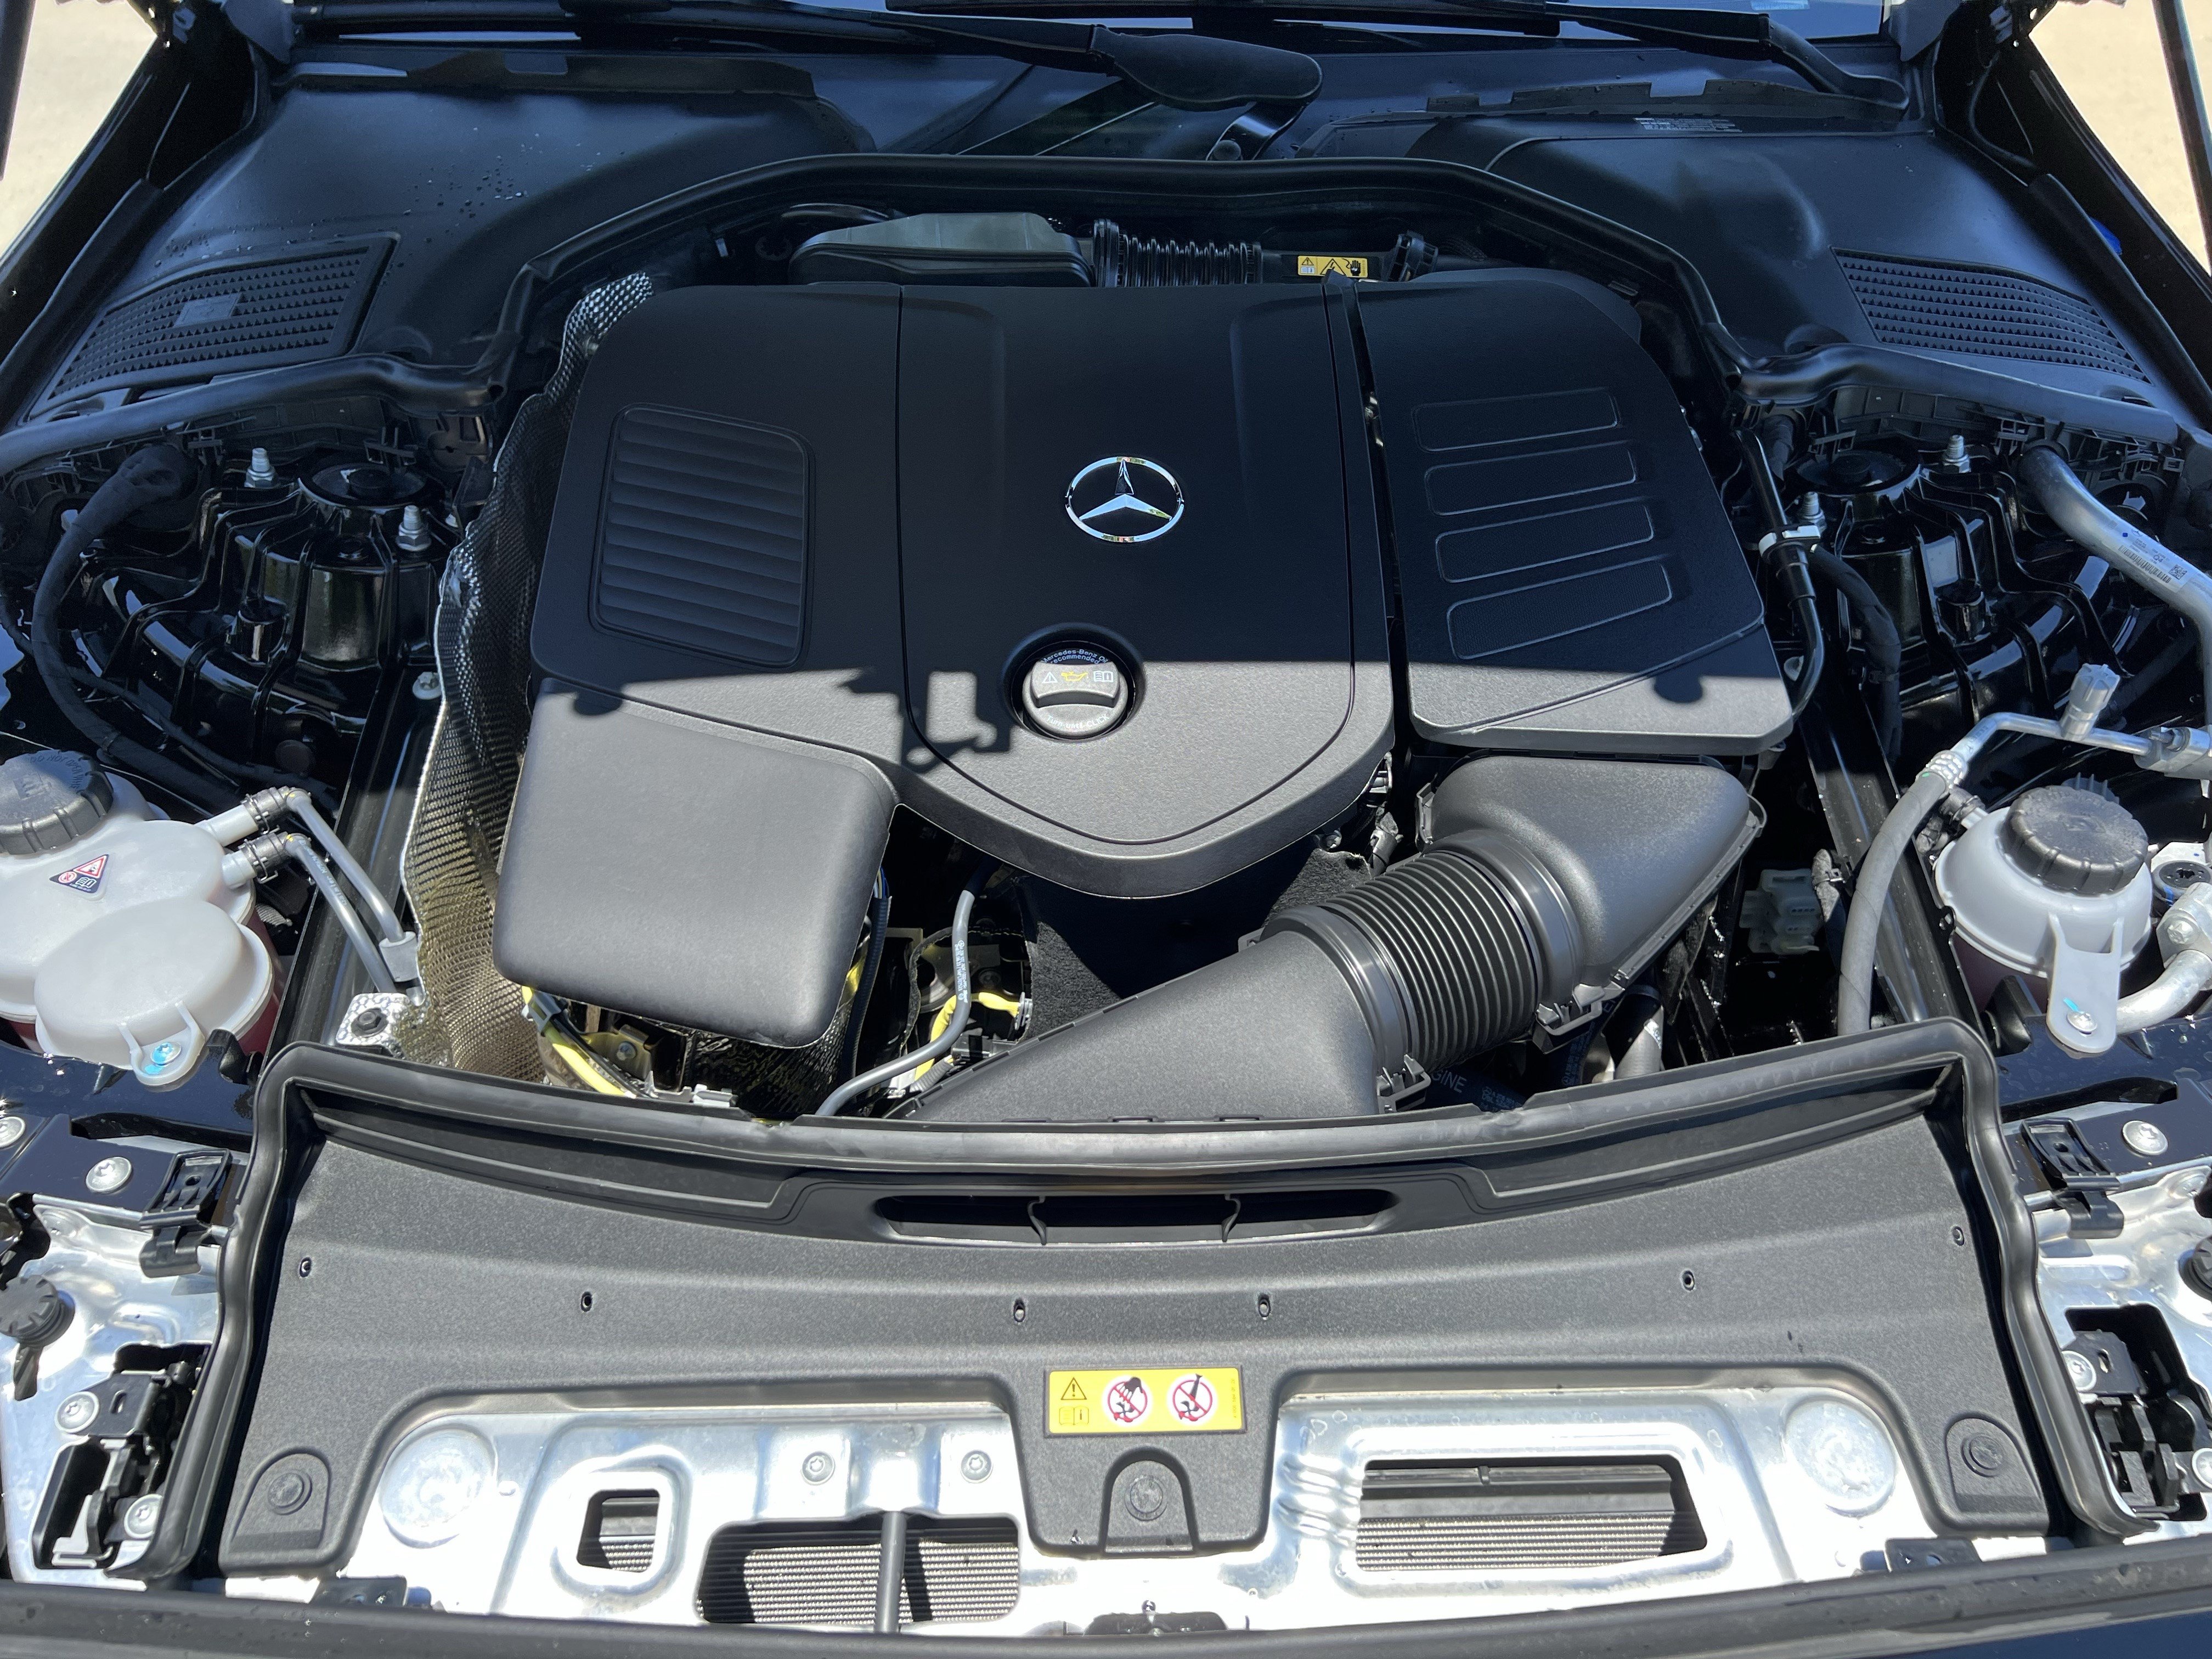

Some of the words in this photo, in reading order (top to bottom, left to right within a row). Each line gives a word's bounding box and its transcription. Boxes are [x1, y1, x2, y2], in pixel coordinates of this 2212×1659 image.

[1041, 649, 1097, 663] Mercedes-Benz
[1050, 654, 1100, 664] recommended
[1086, 714, 1109, 727] CLICK
